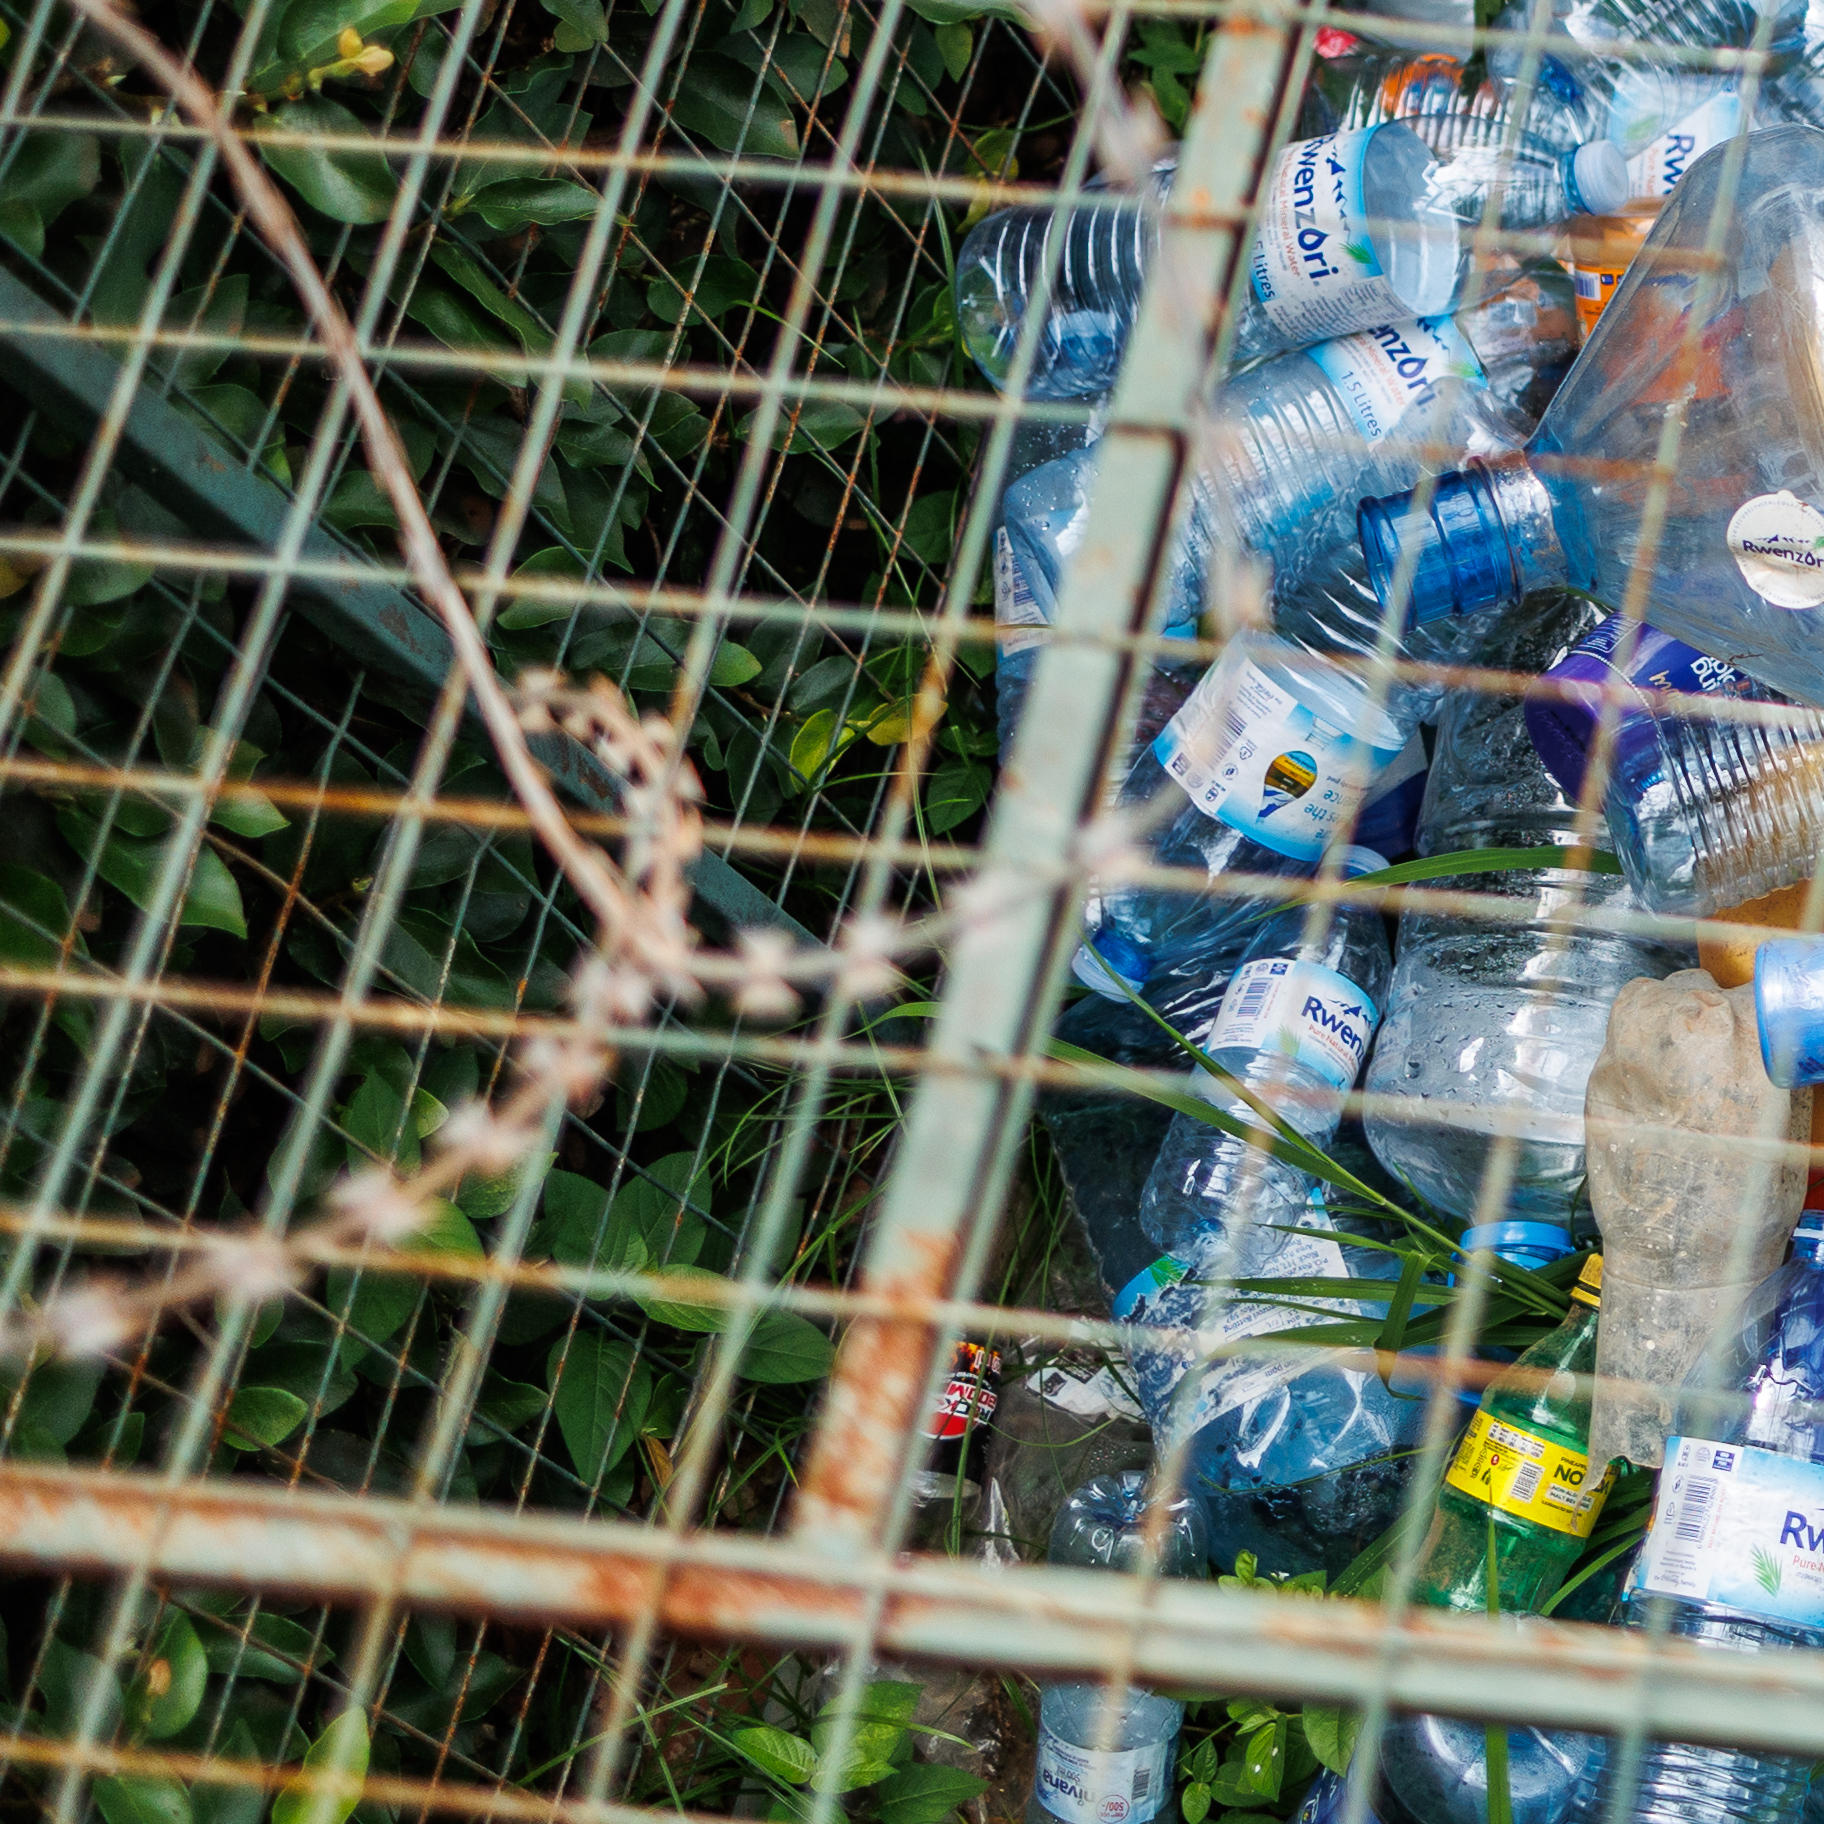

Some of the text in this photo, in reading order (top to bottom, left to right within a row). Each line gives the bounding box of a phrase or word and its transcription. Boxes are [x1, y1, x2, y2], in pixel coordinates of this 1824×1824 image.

[1279, 200, 1292, 242] Mineral
[1293, 133, 1340, 280] Rwenzori
[1252, 253, 1277, 300] Litres
[1285, 241, 1302, 278] Water
[1340, 371, 1383, 438] 1.5 Litres
[1385, 375, 1408, 407] Water
[1303, 802, 1326, 822] the
[1308, 1024, 1351, 1060] Pure Natural
[1792, 1554, 1816, 1571] Pure
